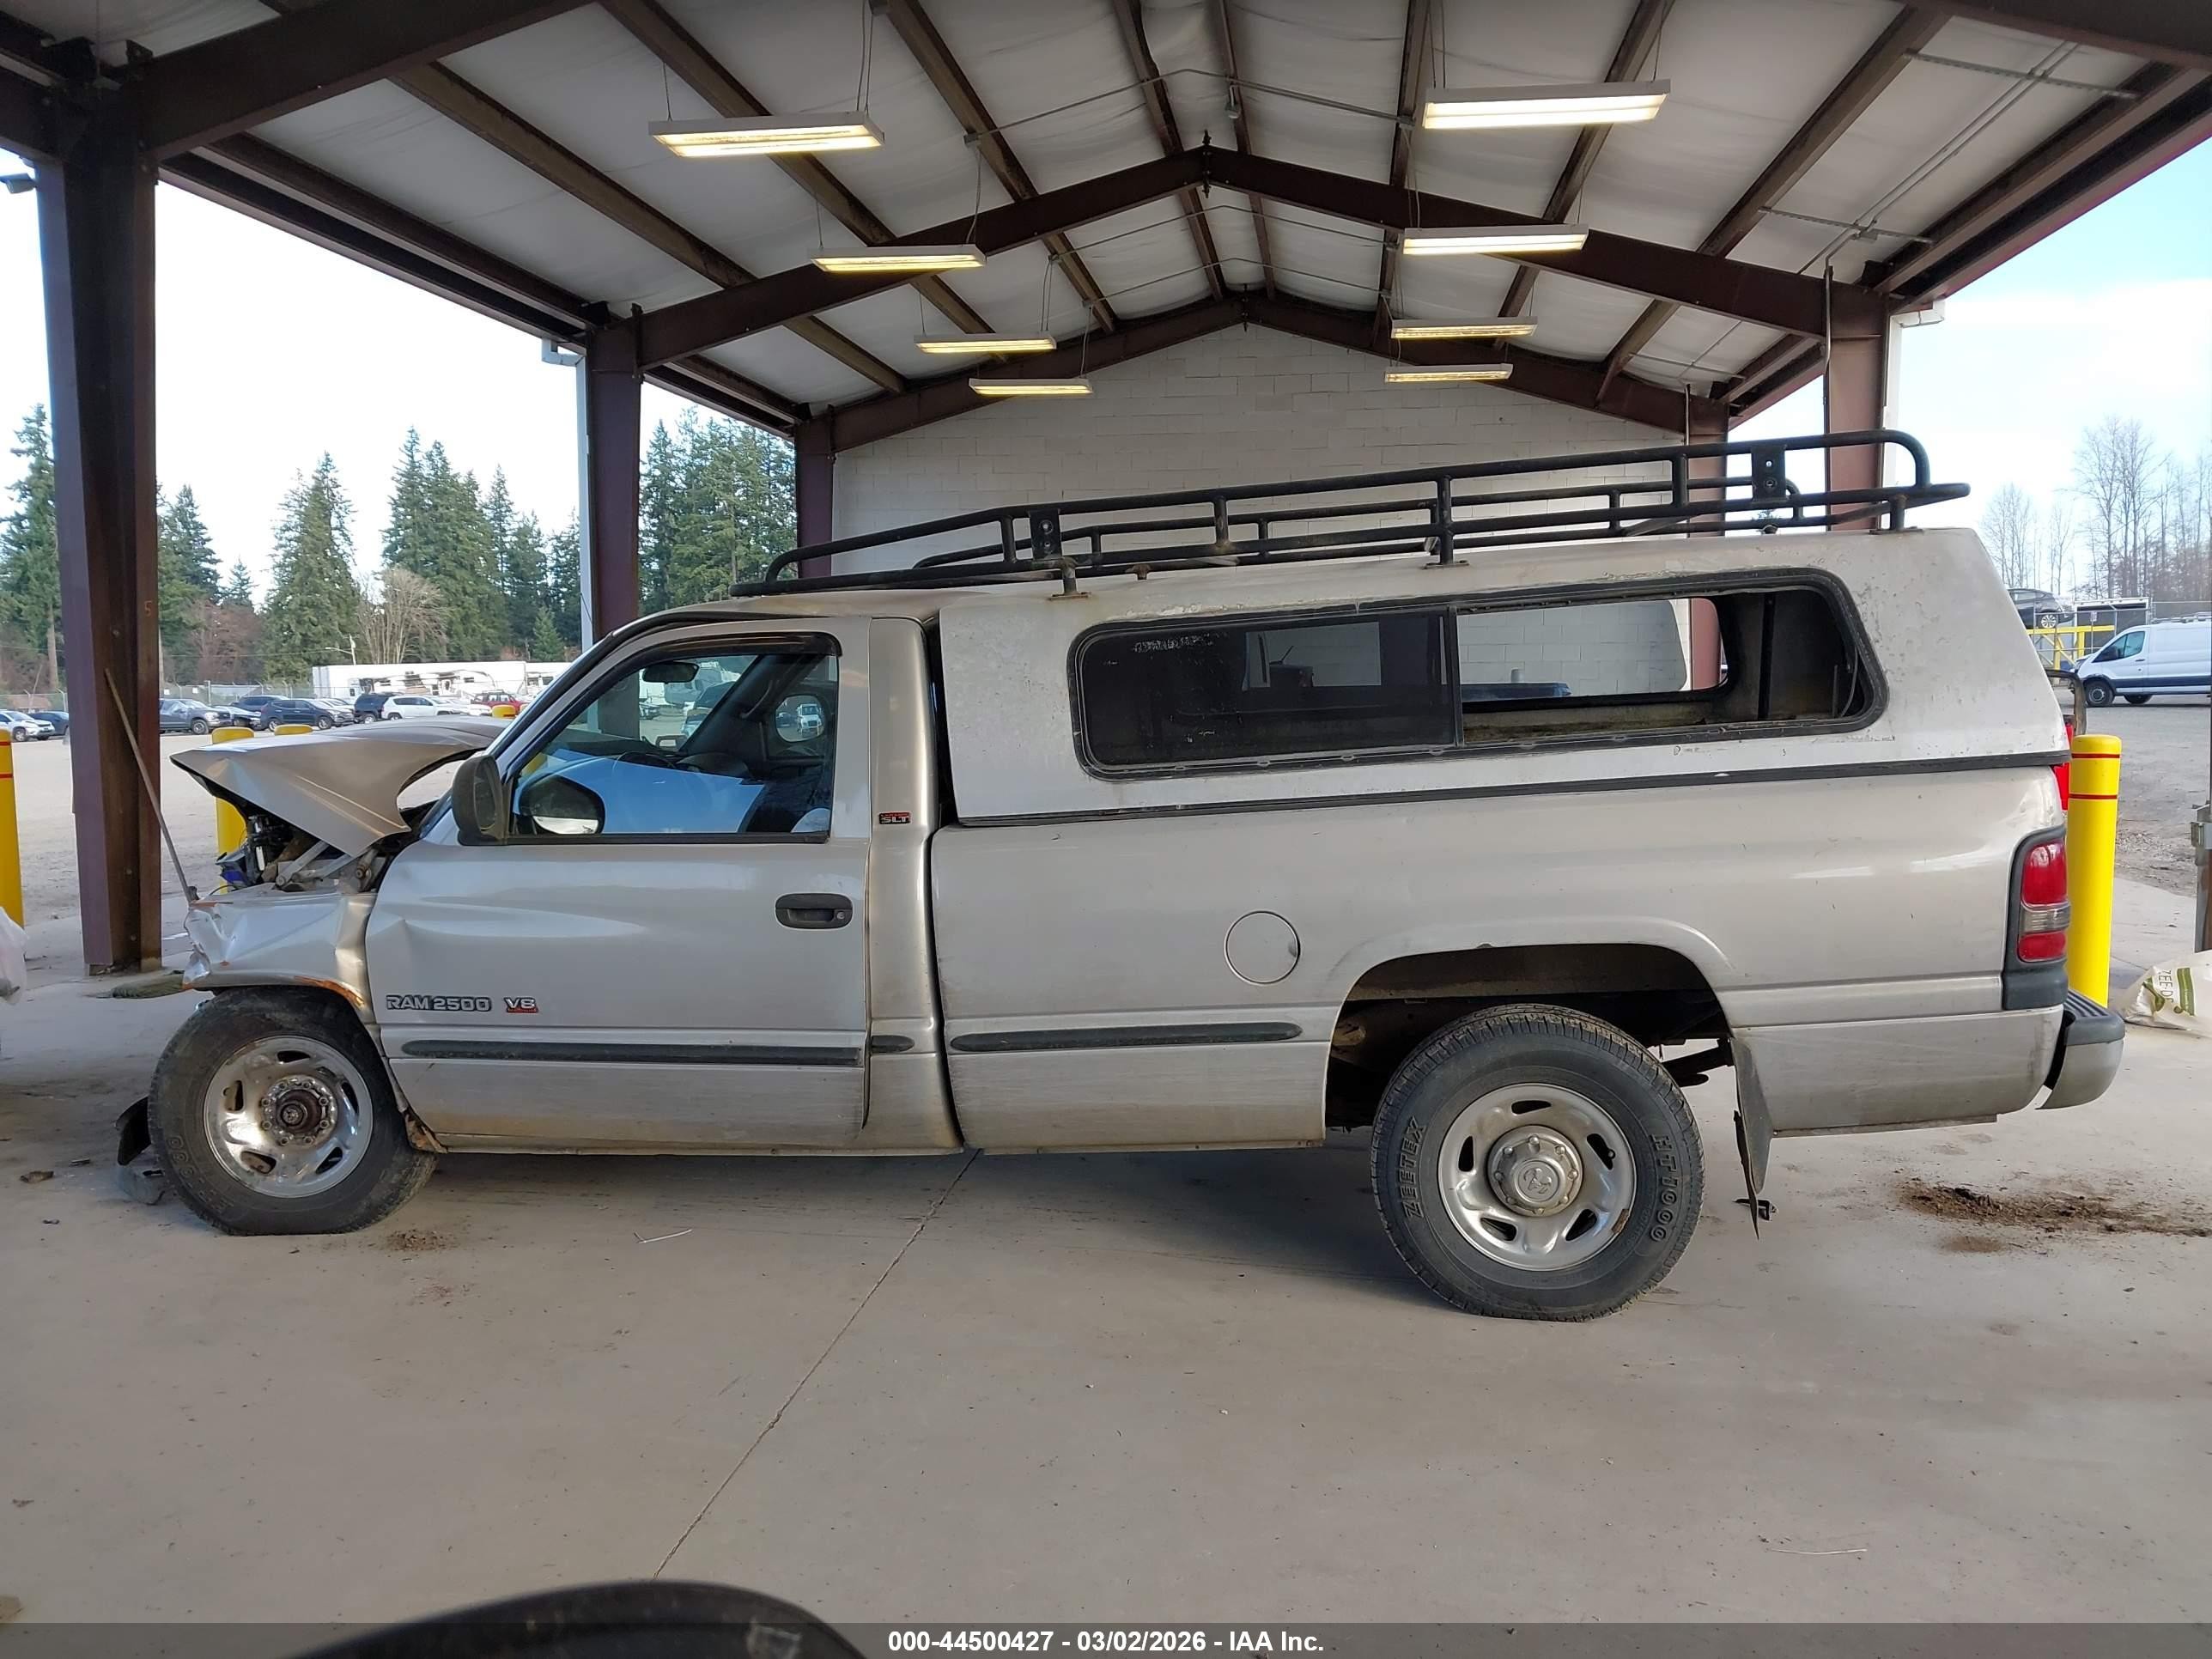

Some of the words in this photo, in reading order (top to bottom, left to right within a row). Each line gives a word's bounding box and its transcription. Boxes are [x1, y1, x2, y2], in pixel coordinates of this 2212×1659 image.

[386, 994, 431, 1011] RAM
[433, 996, 492, 1012] 2500
[503, 996, 538, 1010] V8
[1399, 1115, 1426, 1218] ZEETEX
[1650, 1133, 1678, 1243] HT1000
